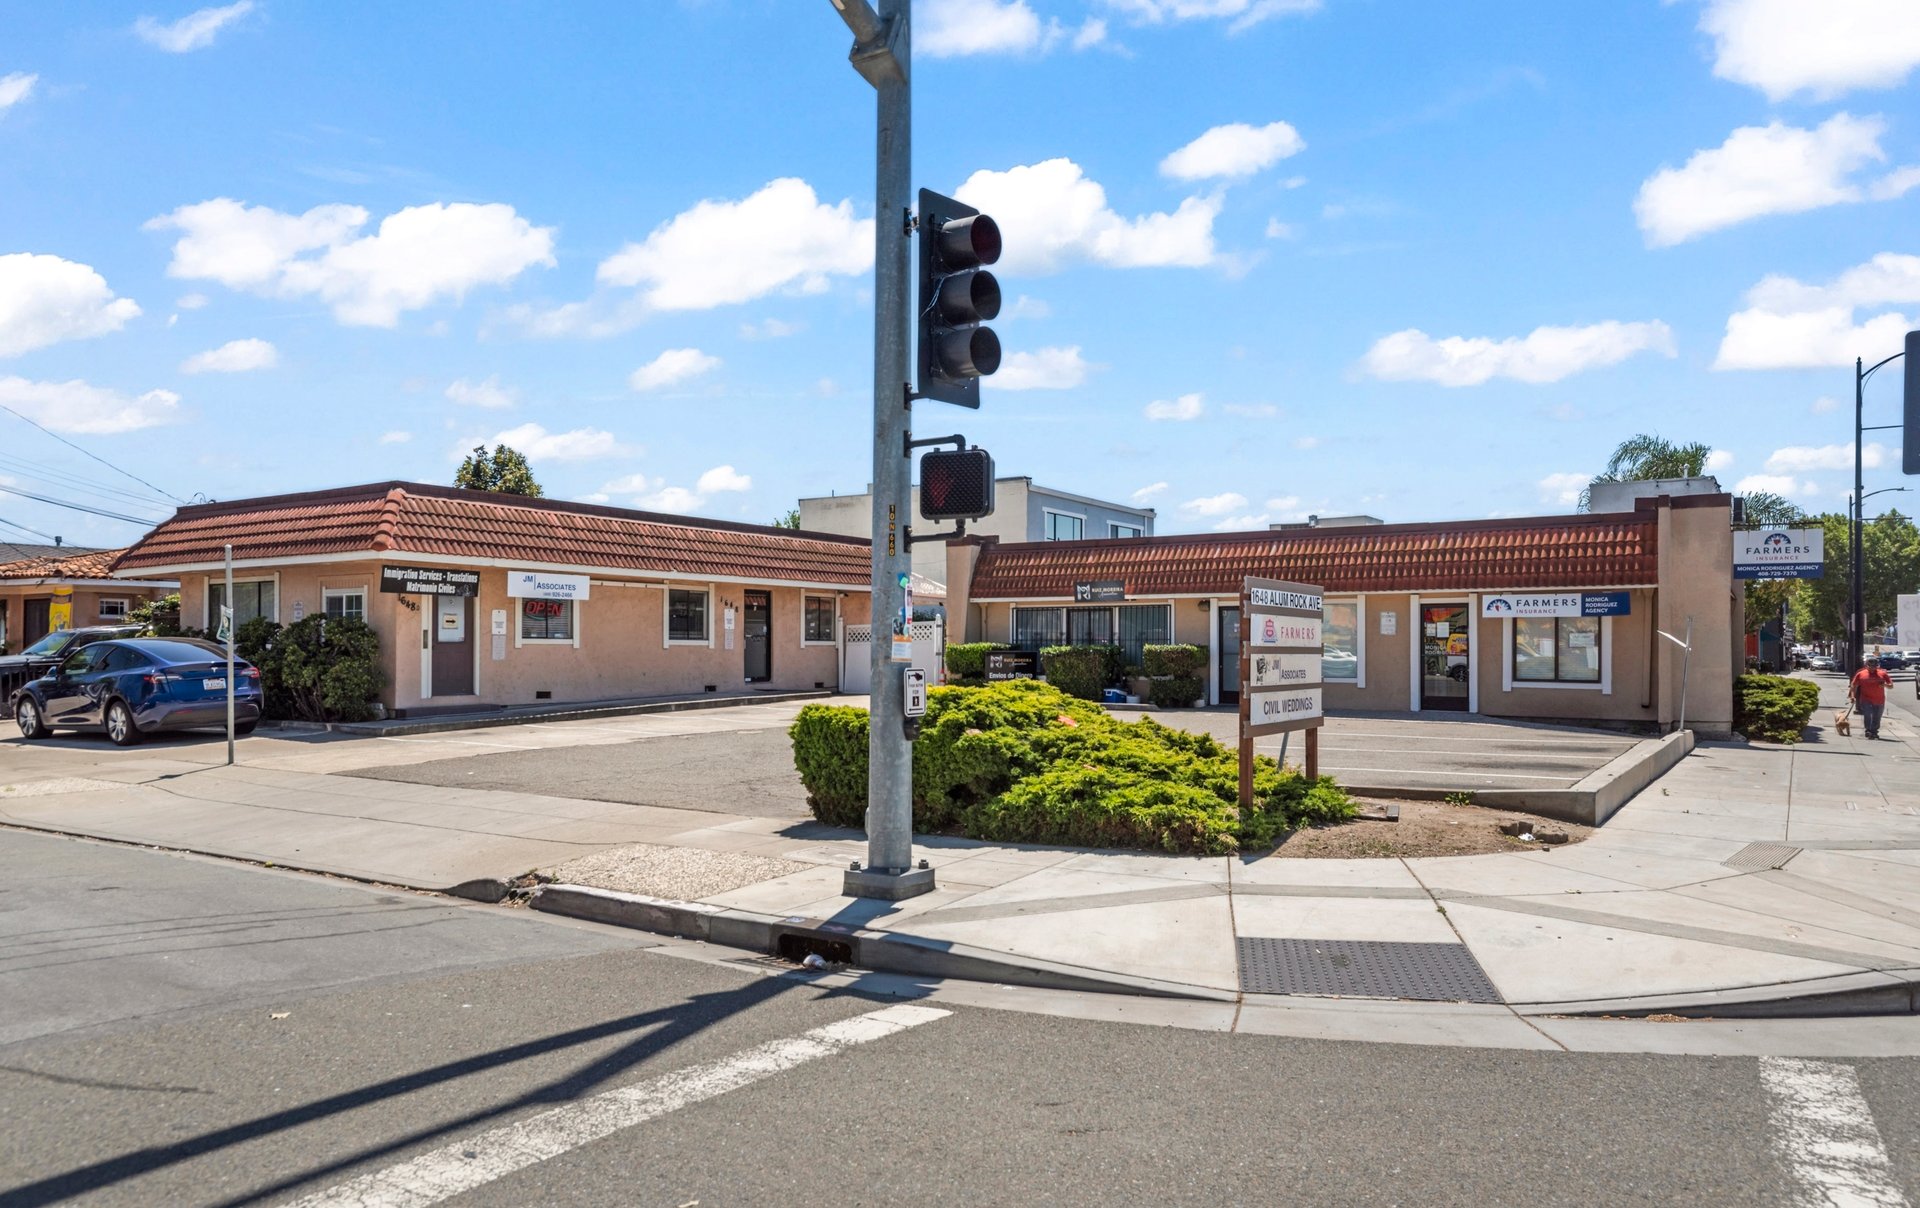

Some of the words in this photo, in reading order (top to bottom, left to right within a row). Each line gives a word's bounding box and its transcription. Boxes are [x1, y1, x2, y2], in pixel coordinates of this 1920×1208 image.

[1746, 546, 1810, 555] FARMERS
[384, 568, 418, 580] Immigration
[418, 570, 442, 581] Services
[447, 572, 478, 583] Translations
[523, 575, 534, 583] JM
[406, 581, 437, 593] Matrimonio
[438, 583, 456, 594] Civiles
[1251, 589, 1269, 605] 1648
[1269, 591, 1289, 606] ALUM
[1289, 594, 1308, 609] ROCK
[1308, 597, 1321, 610] AVE
[1516, 598, 1578, 607] FARMERS
[525, 601, 564, 617] OPEN
[1280, 626, 1315, 640] FARMERS
[1263, 700, 1281, 715] CIVIL
[1281, 697, 1313, 713] WEDDINGS
